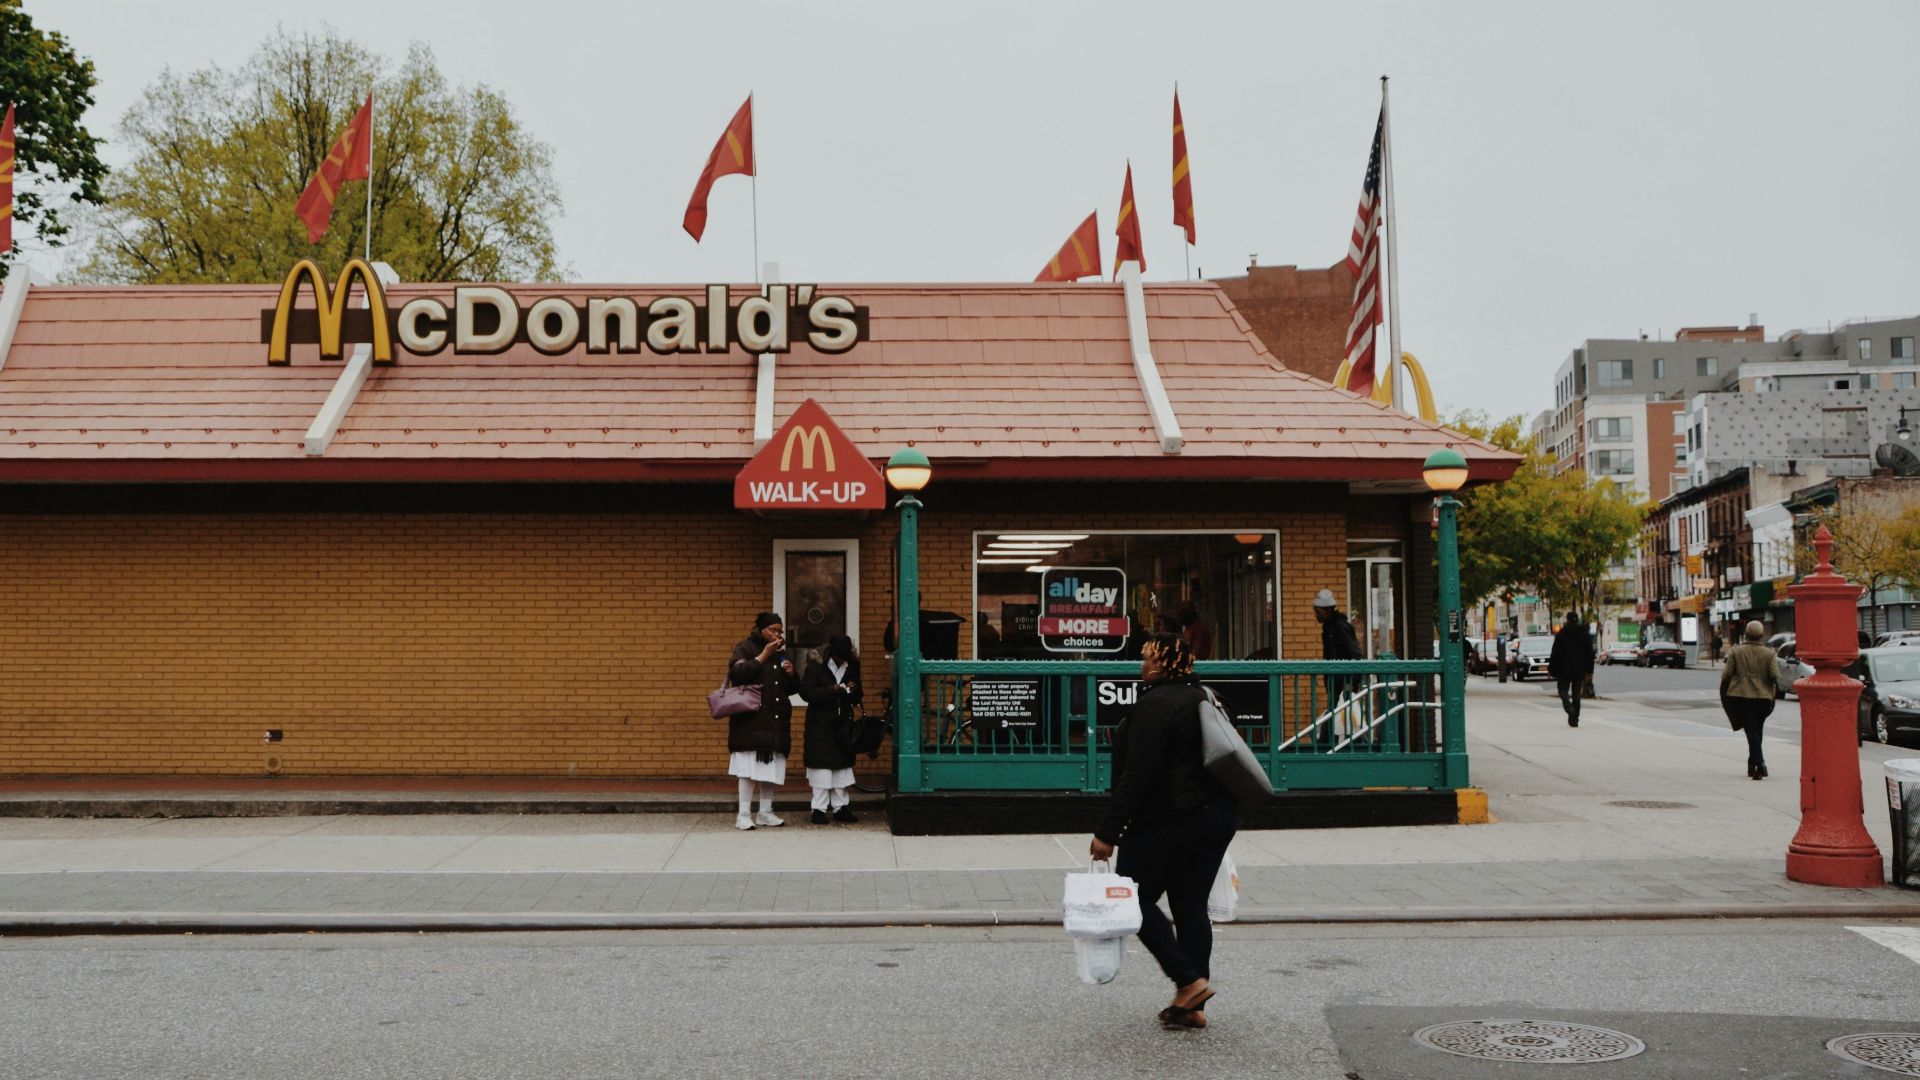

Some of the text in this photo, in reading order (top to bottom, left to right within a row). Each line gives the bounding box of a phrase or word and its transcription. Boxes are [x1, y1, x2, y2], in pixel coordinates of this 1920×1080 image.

[268, 257, 860, 366] McDonald's
[750, 482, 866, 503] WALK-UP
[1075, 583, 1118, 607] day
[1049, 604, 1117, 614] BREAKFAST
[1059, 619, 1110, 634] MORE
[1063, 636, 1104, 647] choices
